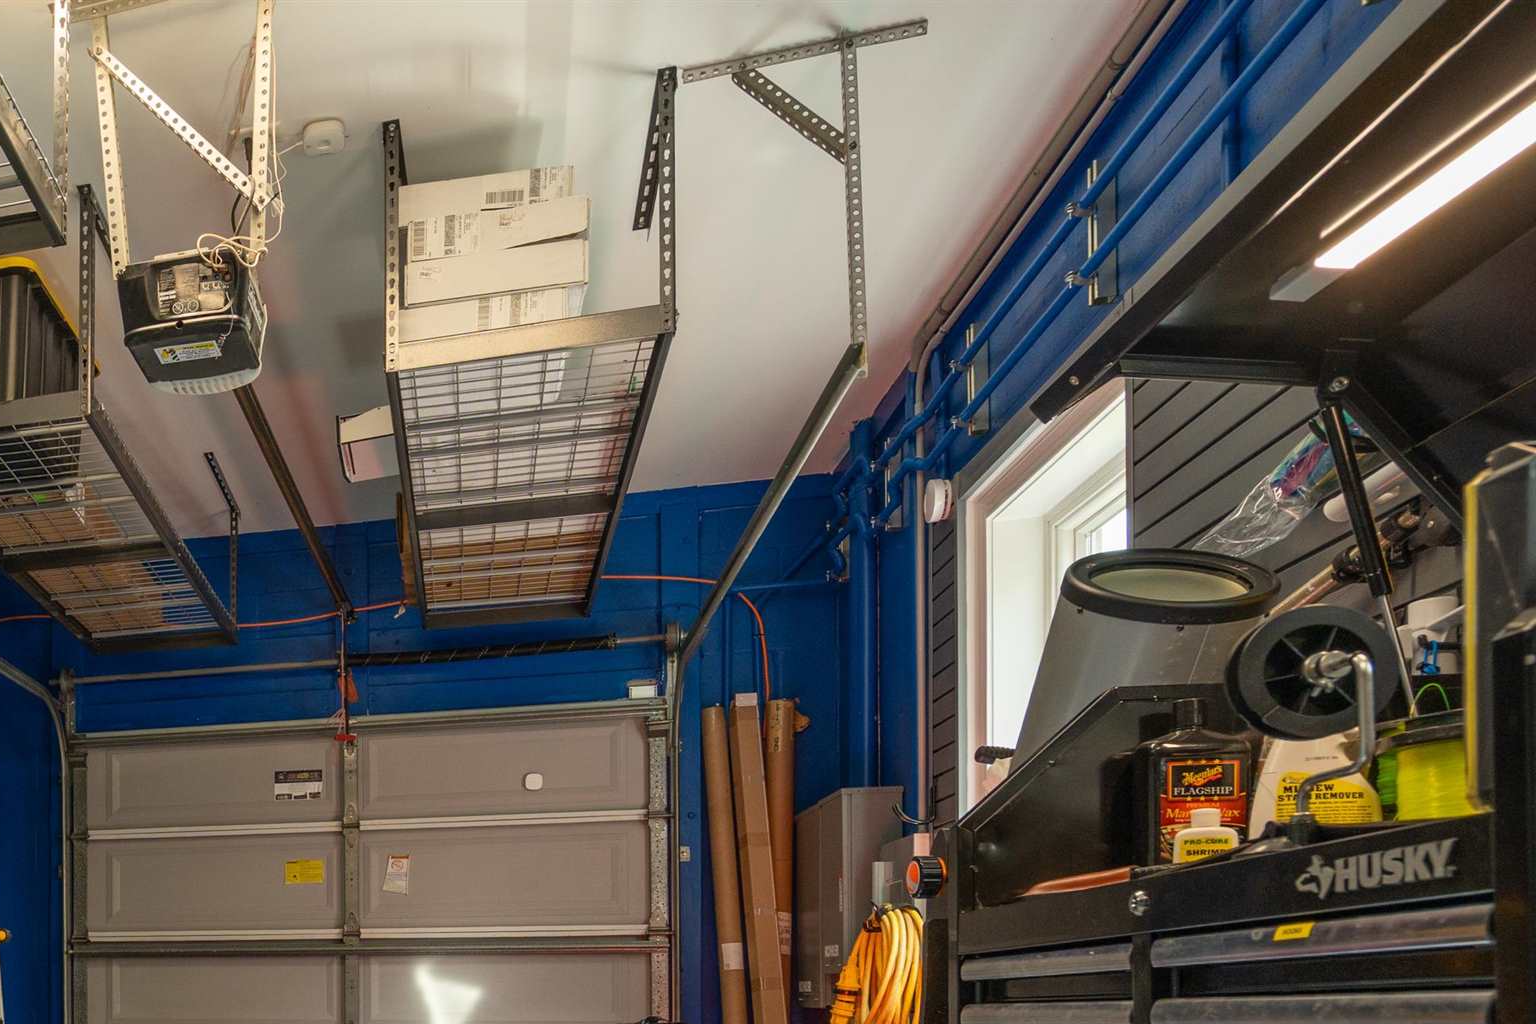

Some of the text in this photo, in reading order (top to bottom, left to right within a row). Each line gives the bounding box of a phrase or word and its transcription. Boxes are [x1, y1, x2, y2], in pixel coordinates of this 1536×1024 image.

[1173, 786, 1233, 796] FLAGSHIP
[1315, 791, 1364, 800] REMOVER
[1332, 837, 1459, 894] HUSKY
